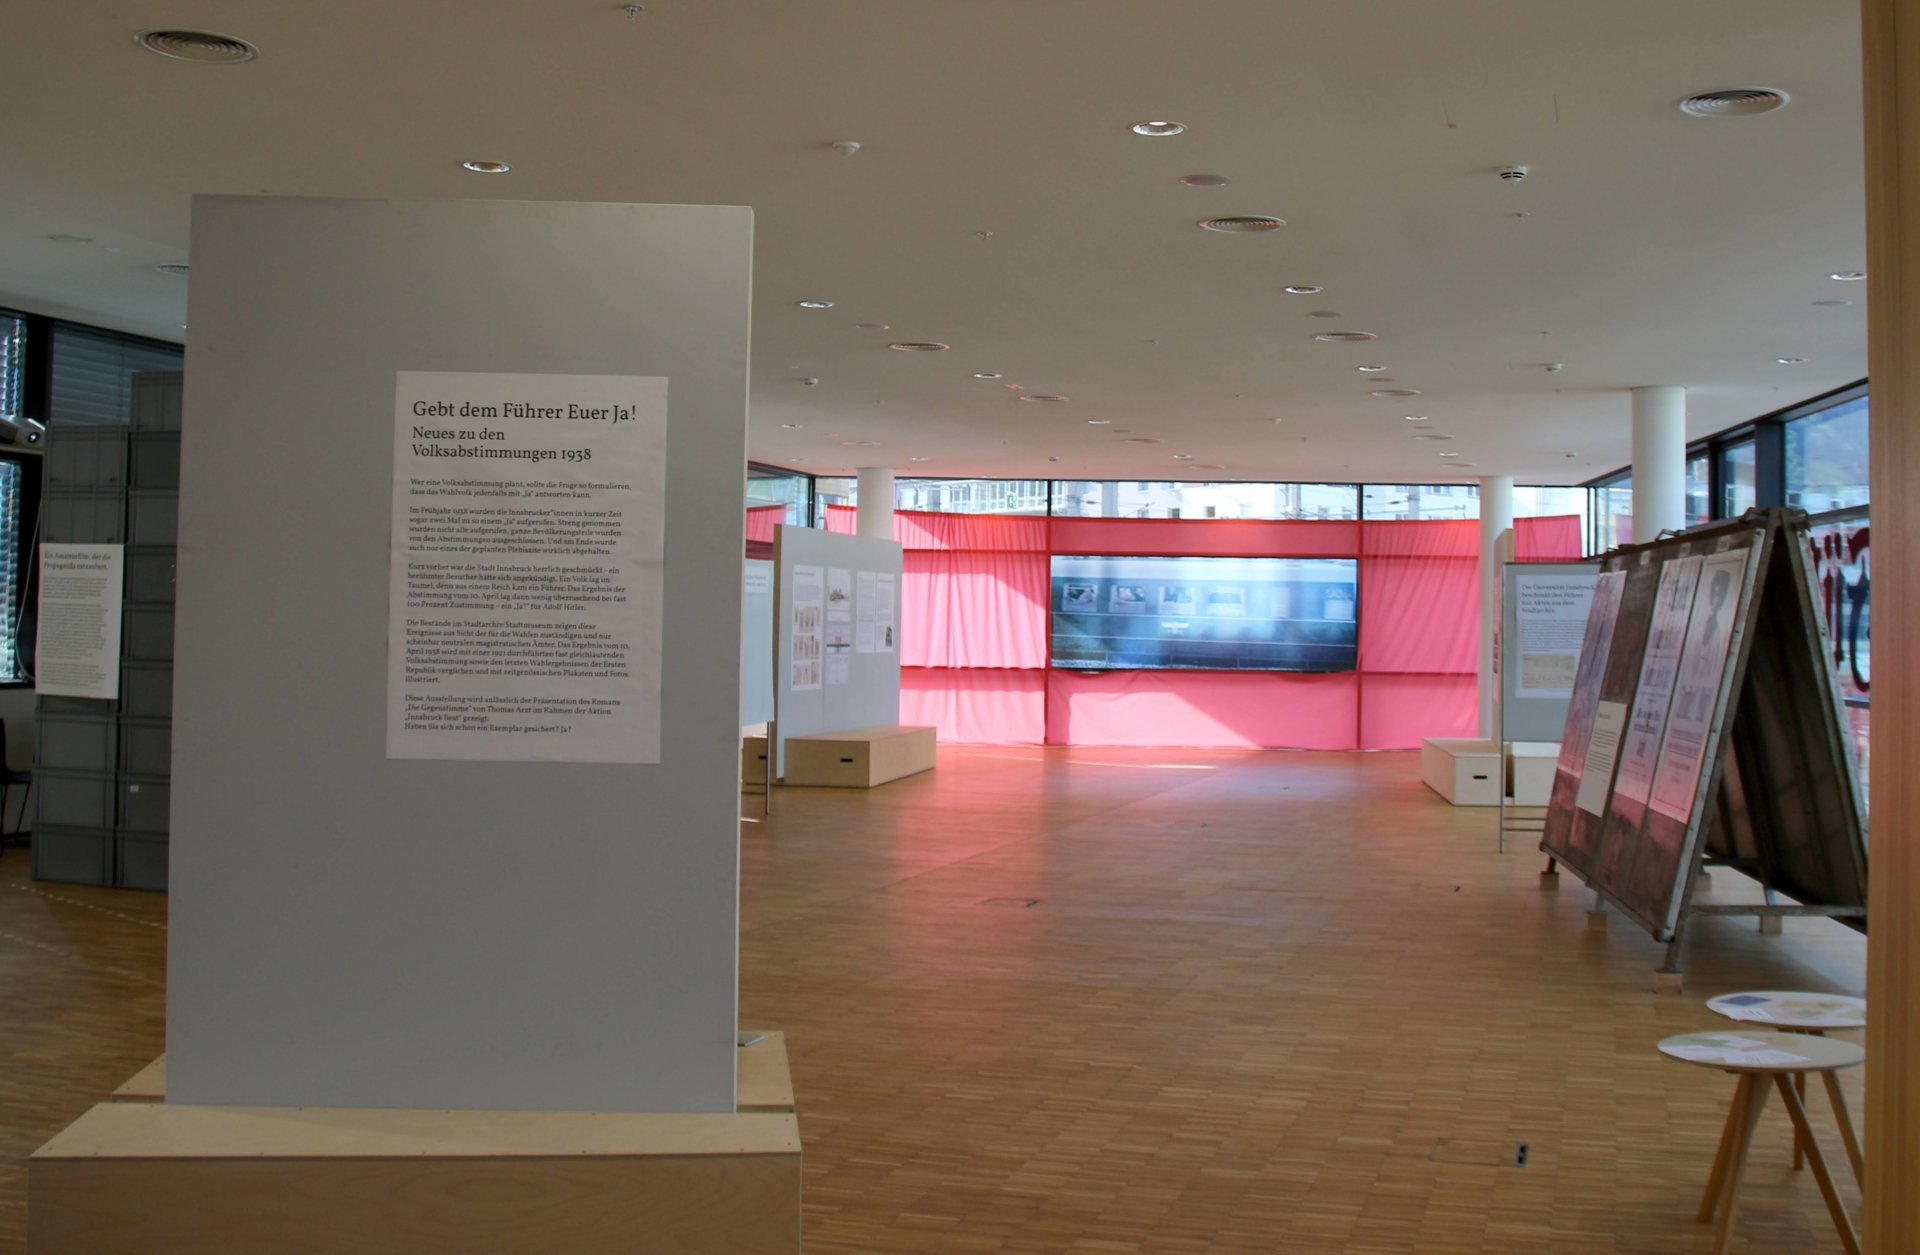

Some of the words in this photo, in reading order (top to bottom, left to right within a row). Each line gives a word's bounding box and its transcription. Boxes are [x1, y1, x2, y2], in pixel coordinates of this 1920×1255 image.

[413, 401, 456, 417] Gebt
[459, 402, 498, 418] dem
[503, 403, 564, 419] Führer
[567, 404, 609, 420] Euer
[612, 405, 636, 425] Ja!
[413, 426, 456, 440] Neues
[458, 430, 476, 440] zu
[479, 428, 505, 441] den
[412, 444, 558, 463] Volksabstimmungen
[561, 448, 592, 463] 1938
[442, 479, 504, 489] Volksabstimmung
[558, 481, 578, 491] Frage
[474, 489, 507, 498] jedenfalls
[420, 506, 451, 516] Frühjahr
[437, 535, 492, 545] Abstimmungen
[472, 545, 506, 555] geplanten
[572, 547, 611, 557] abgehalten.
[562, 566, 603, 575] geschmückt
[512, 574, 558, 584] angekündigt.
[588, 576, 600, 585] lag
[555, 622, 577, 631] zeigen
[406, 657, 468, 667] Volksabstimmung
[529, 659, 589, 669] Wahlergebnissen
[405, 666, 437, 676] Republik
[438, 667, 474, 676] verglichen
[504, 668, 562, 678] zeitgenössischen
[426, 694, 466, 704] Ausstellung
[533, 697, 577, 705] Präsentation
[489, 724, 522, 734] Exemplar
